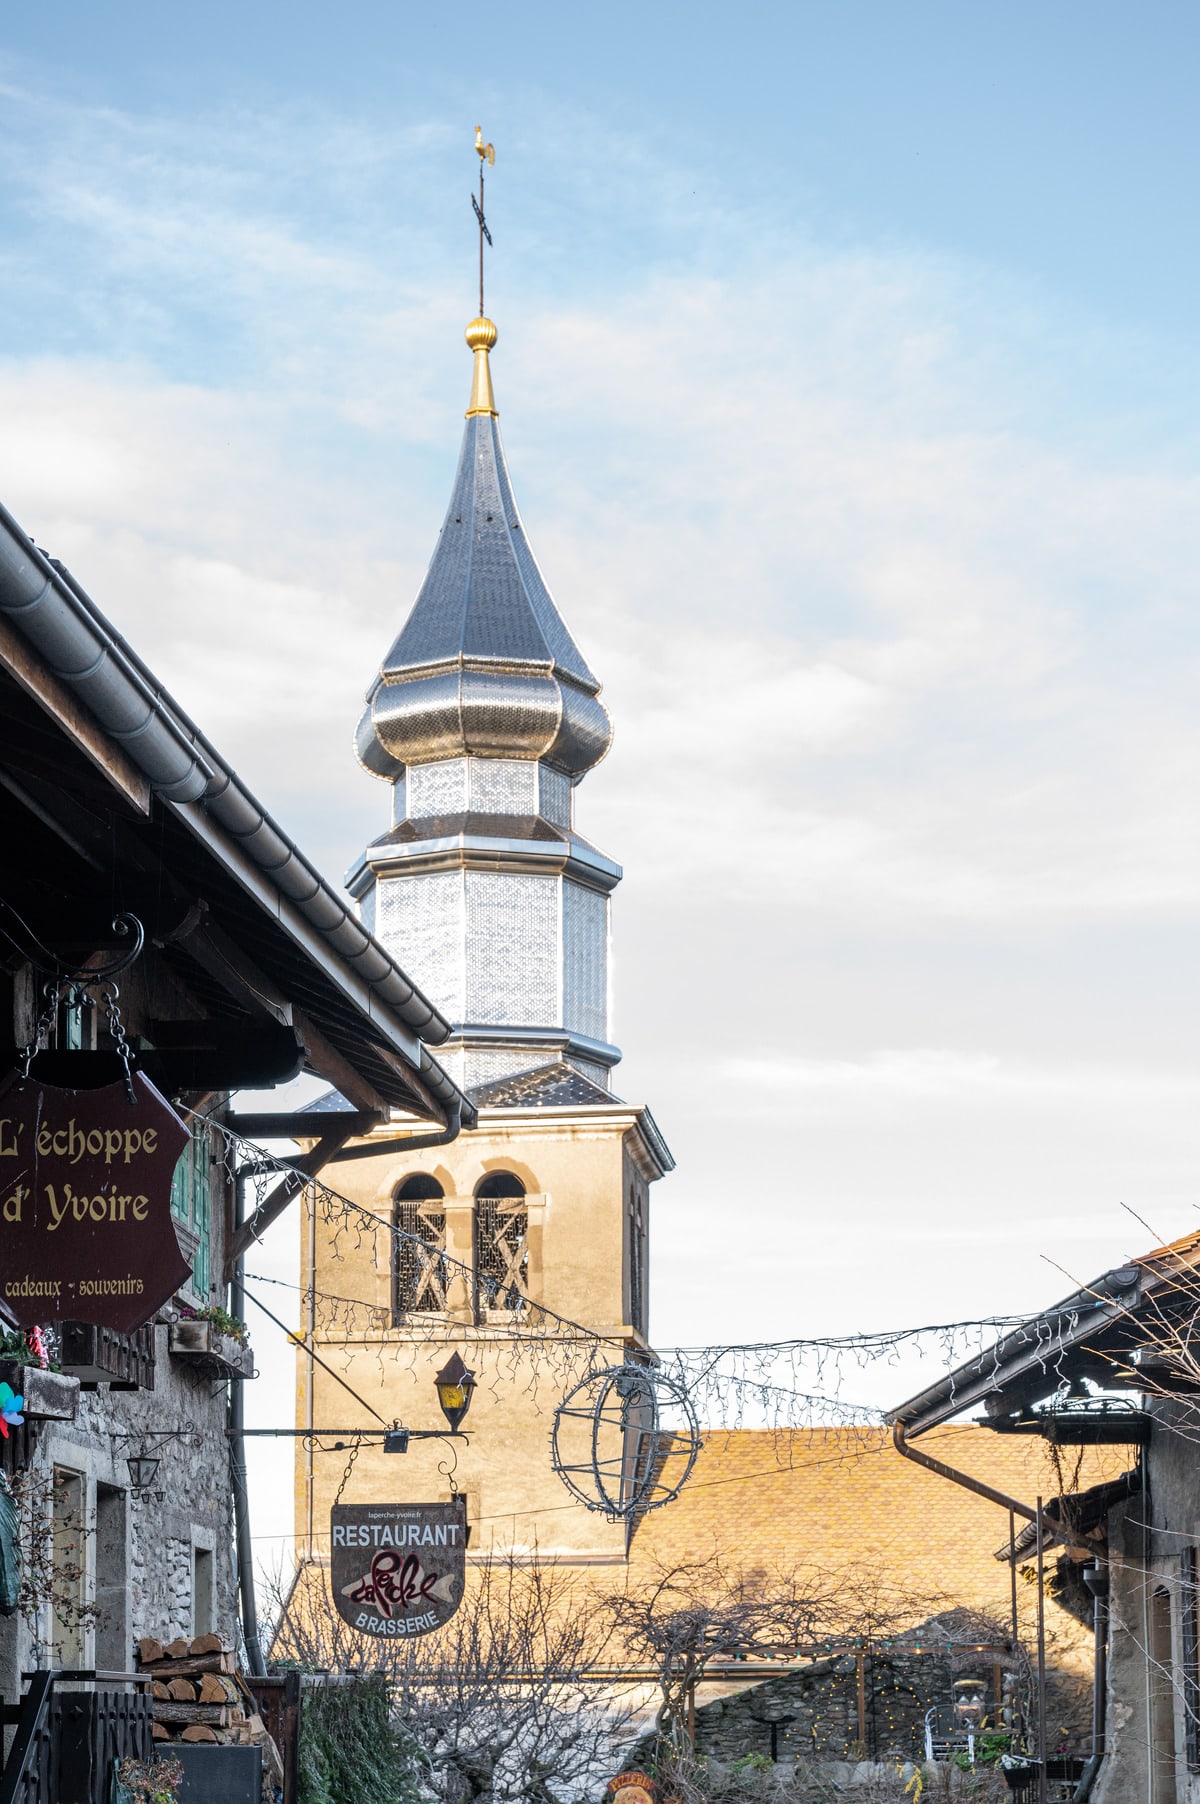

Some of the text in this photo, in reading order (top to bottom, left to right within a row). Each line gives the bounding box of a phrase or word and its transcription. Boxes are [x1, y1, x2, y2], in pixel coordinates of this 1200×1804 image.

[37, 1118, 158, 1165] échoppe
[44, 1183, 150, 1231] Yvoire
[5, 1274, 62, 1297] cadeaux
[79, 1273, 144, 1296] souvenirs
[368, 1511, 422, 1520] laperche-yvoire.fr
[332, 1524, 459, 1547] RESTAURANT
[355, 1610, 439, 1635] BRASSERIE
